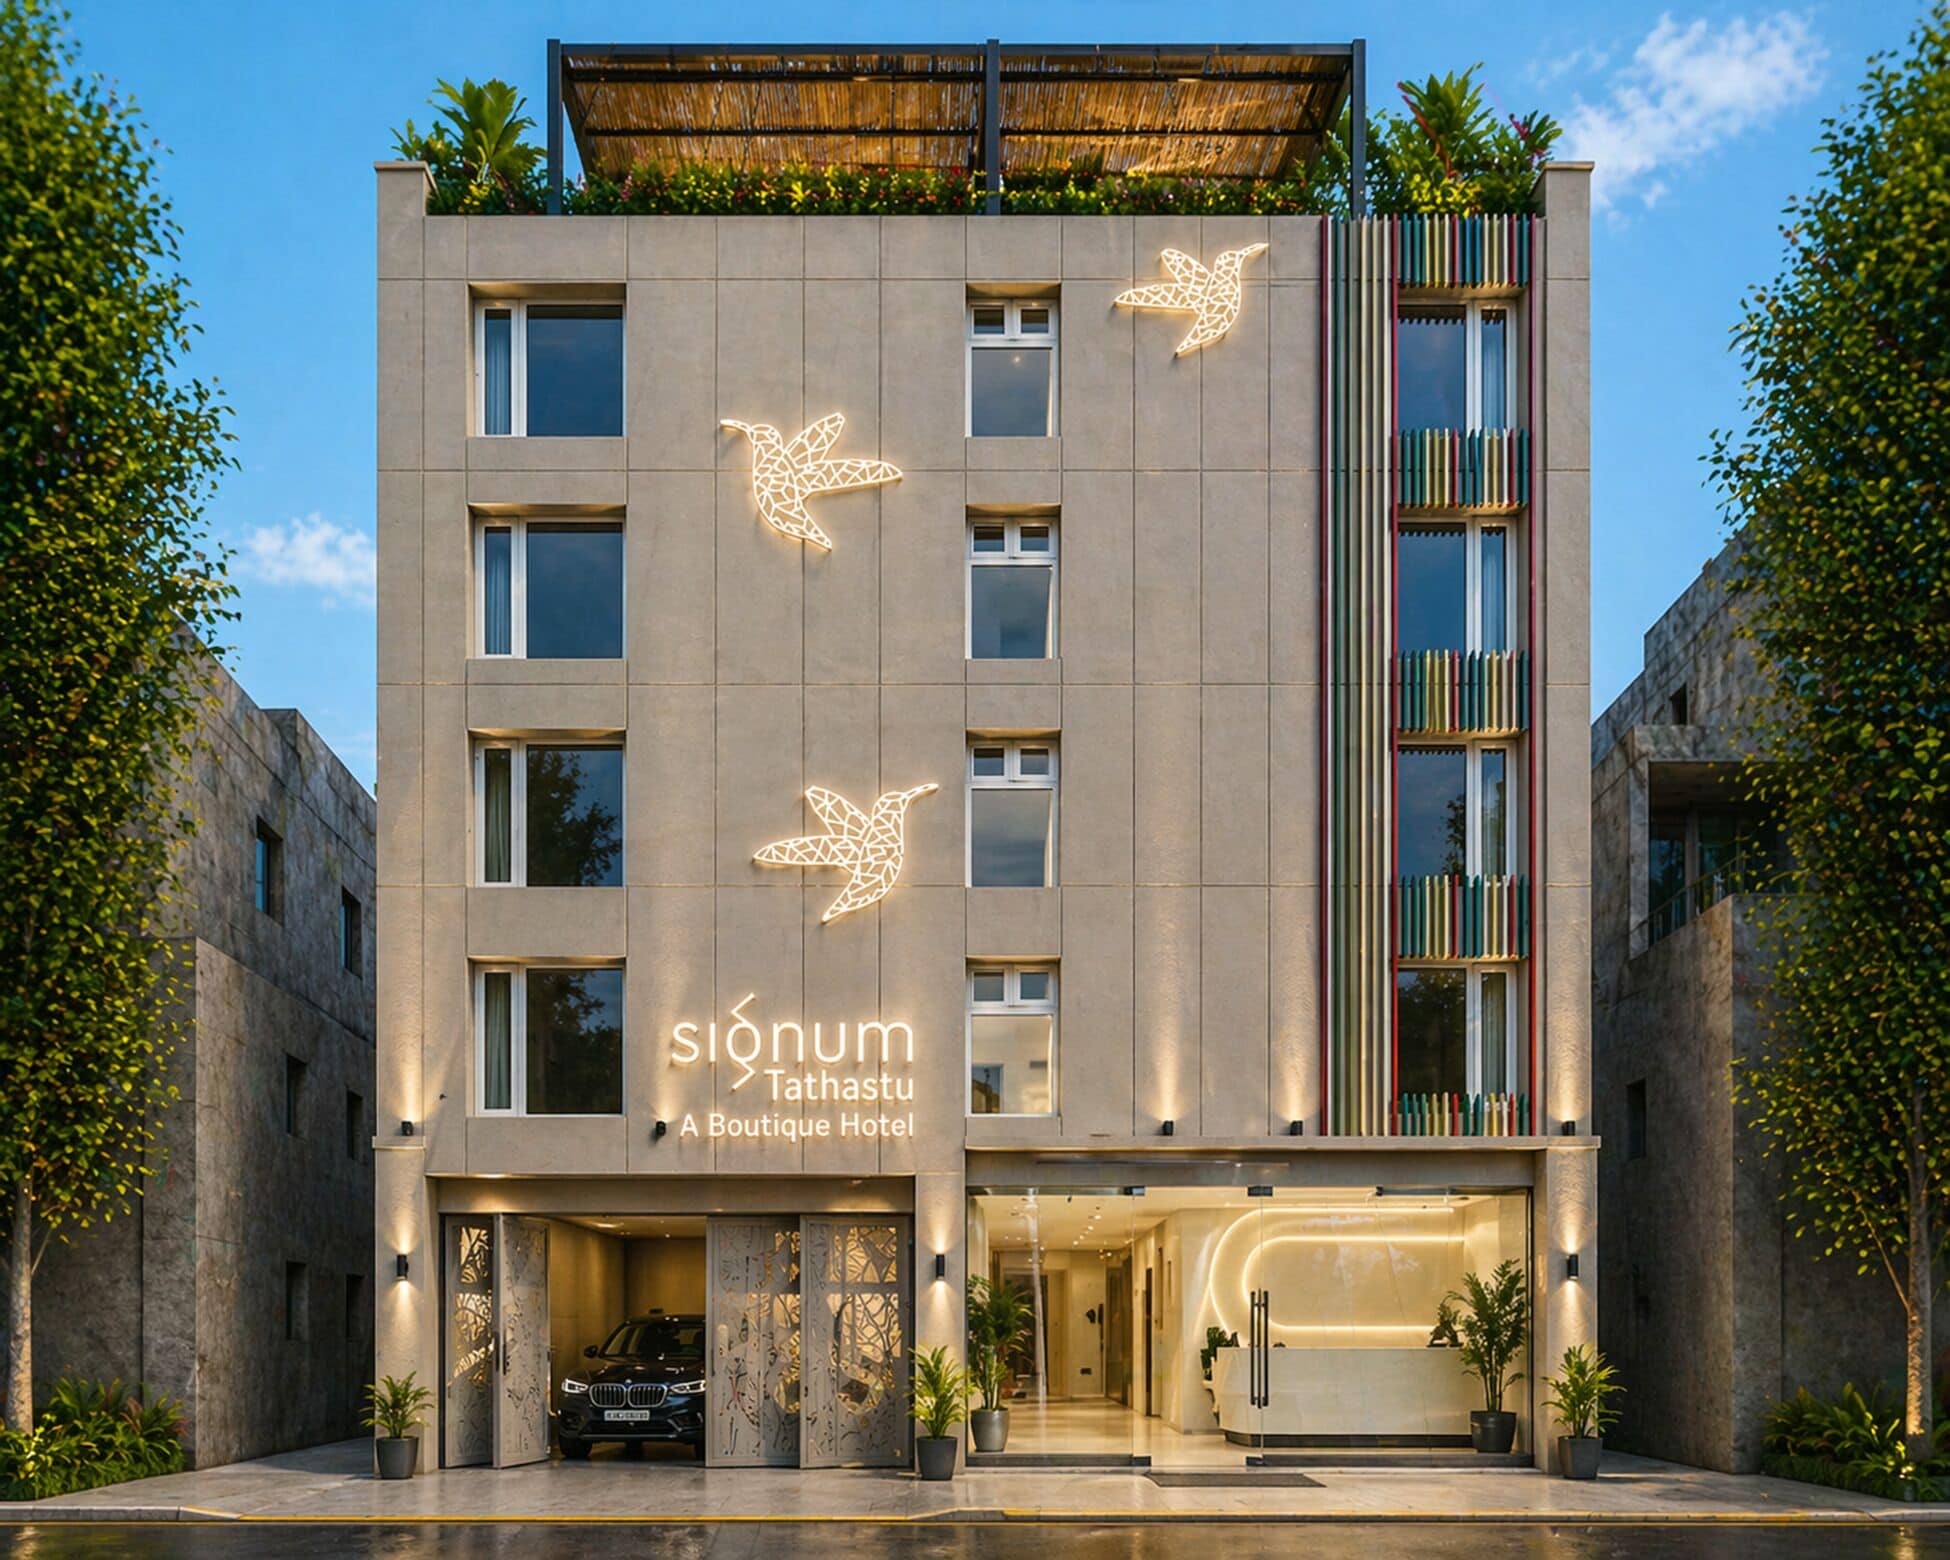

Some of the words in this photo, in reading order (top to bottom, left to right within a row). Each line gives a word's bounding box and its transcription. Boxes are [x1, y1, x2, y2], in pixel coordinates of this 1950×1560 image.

[764, 1069, 913, 1101] Tathastu
[680, 1114, 699, 1137] A
[708, 1113, 831, 1143] Boutique
[841, 1113, 913, 1137] Hotel
